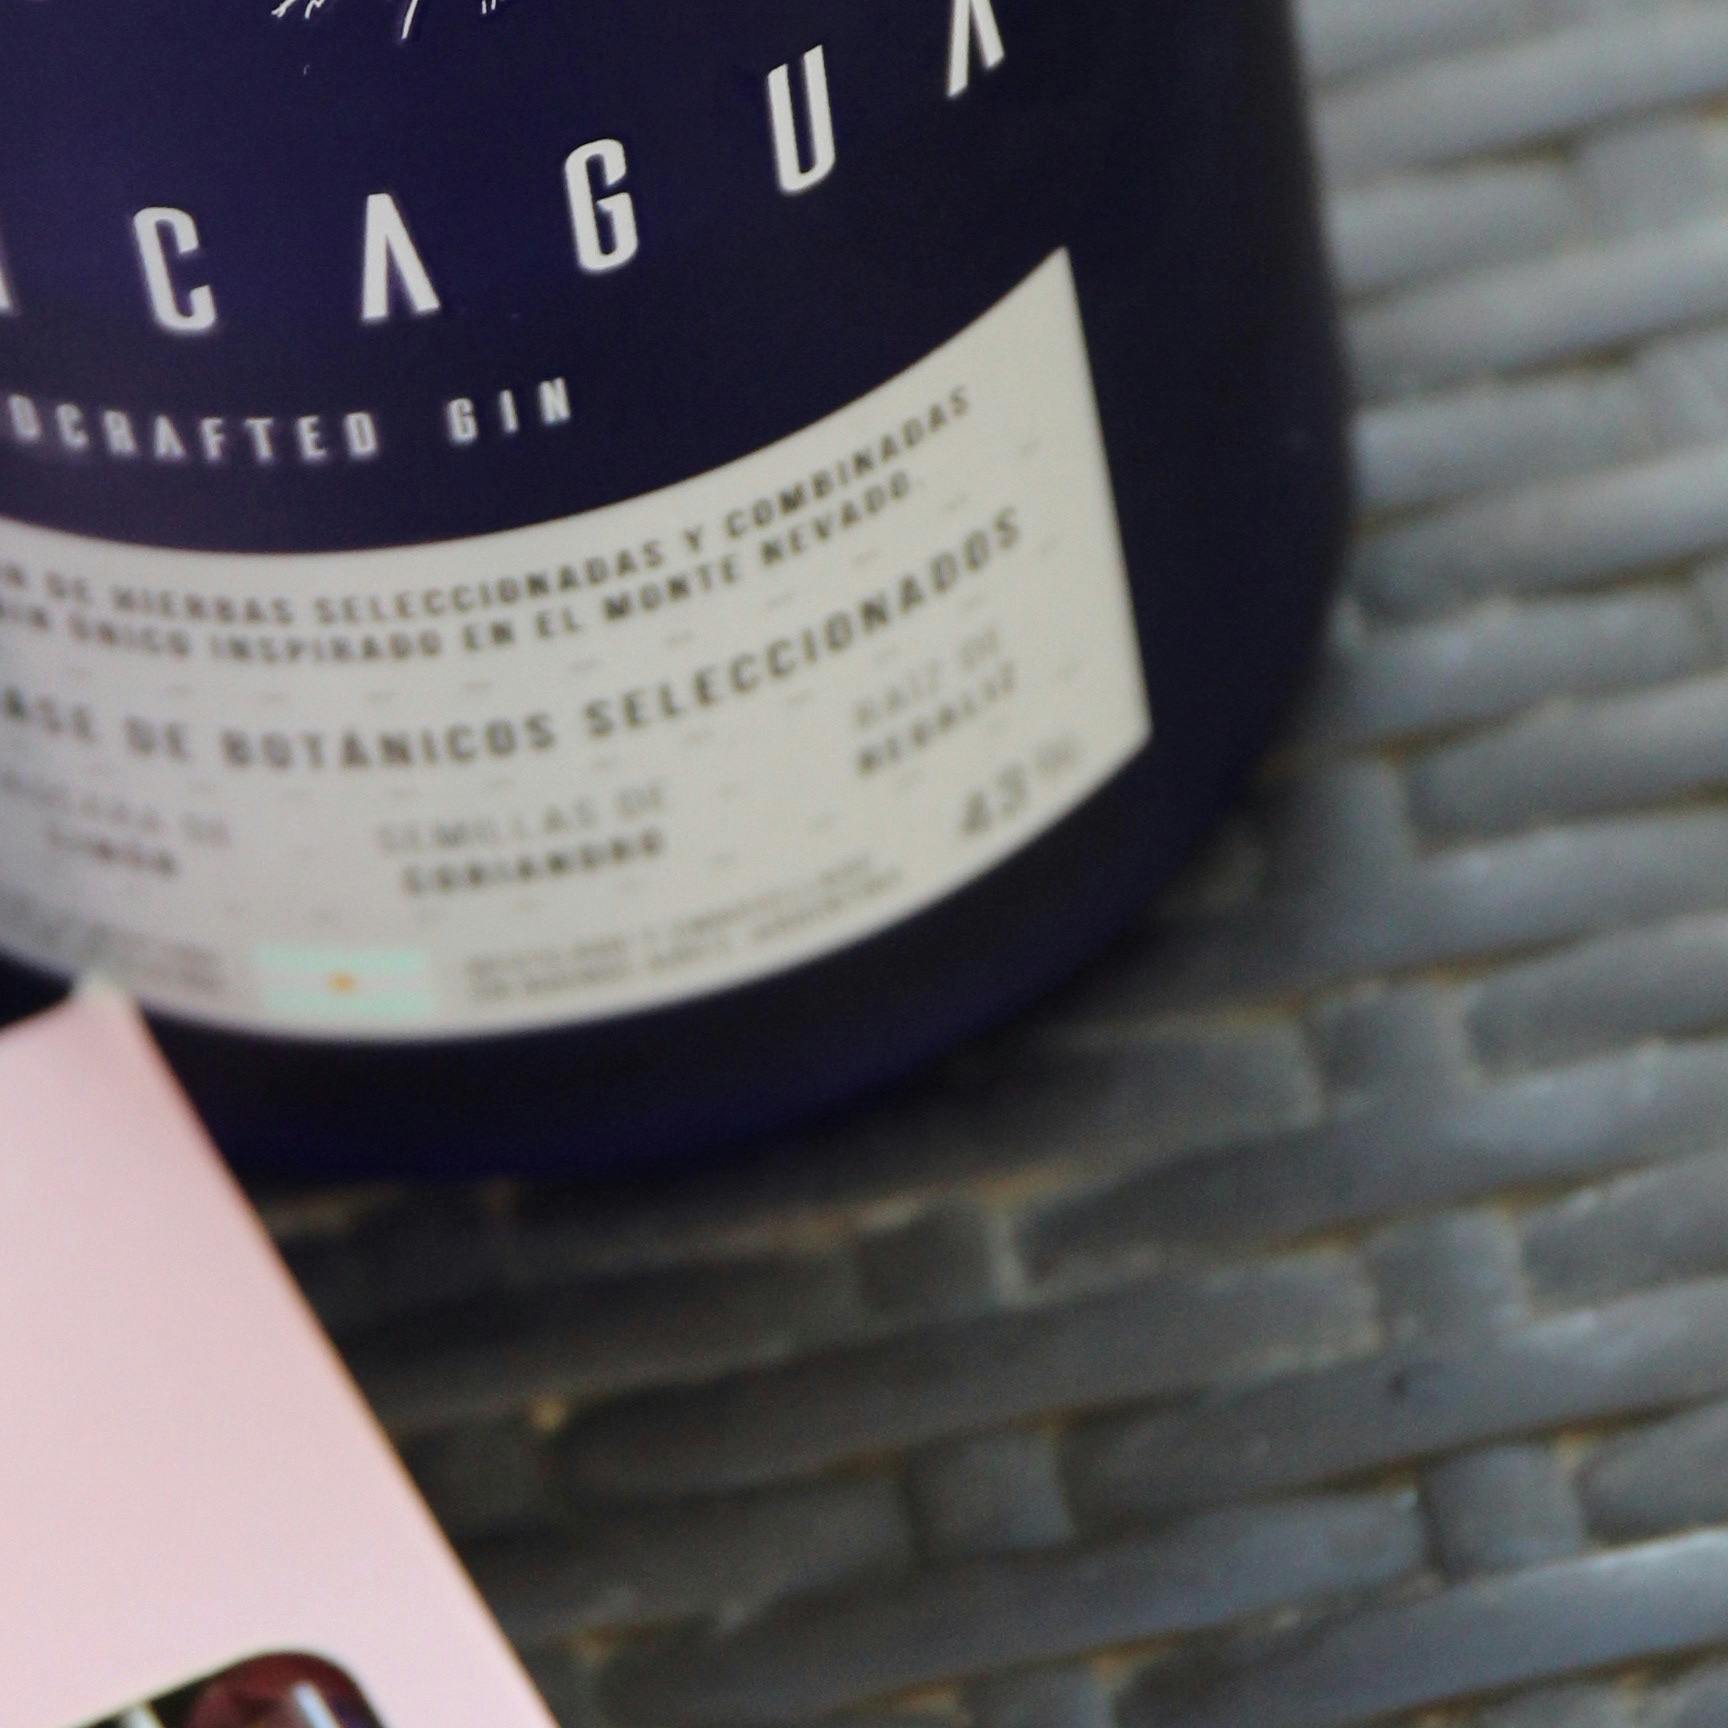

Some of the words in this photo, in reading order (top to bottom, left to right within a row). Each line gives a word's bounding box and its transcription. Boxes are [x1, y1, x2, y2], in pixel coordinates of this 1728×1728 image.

[447, 375, 573, 446] GIN
[110, 583, 296, 625] HIERBAS
[312, 538, 665, 625] SELECCIONADAS
[681, 522, 704, 553] Y
[724, 384, 969, 539] COMBINADAS
[209, 627, 443, 666] INSPIRADO
[462, 618, 515, 651] EN
[534, 604, 582, 640] EL
[603, 554, 740, 622] MONTE
[584, 504, 1022, 743] SELECCIONADOS
